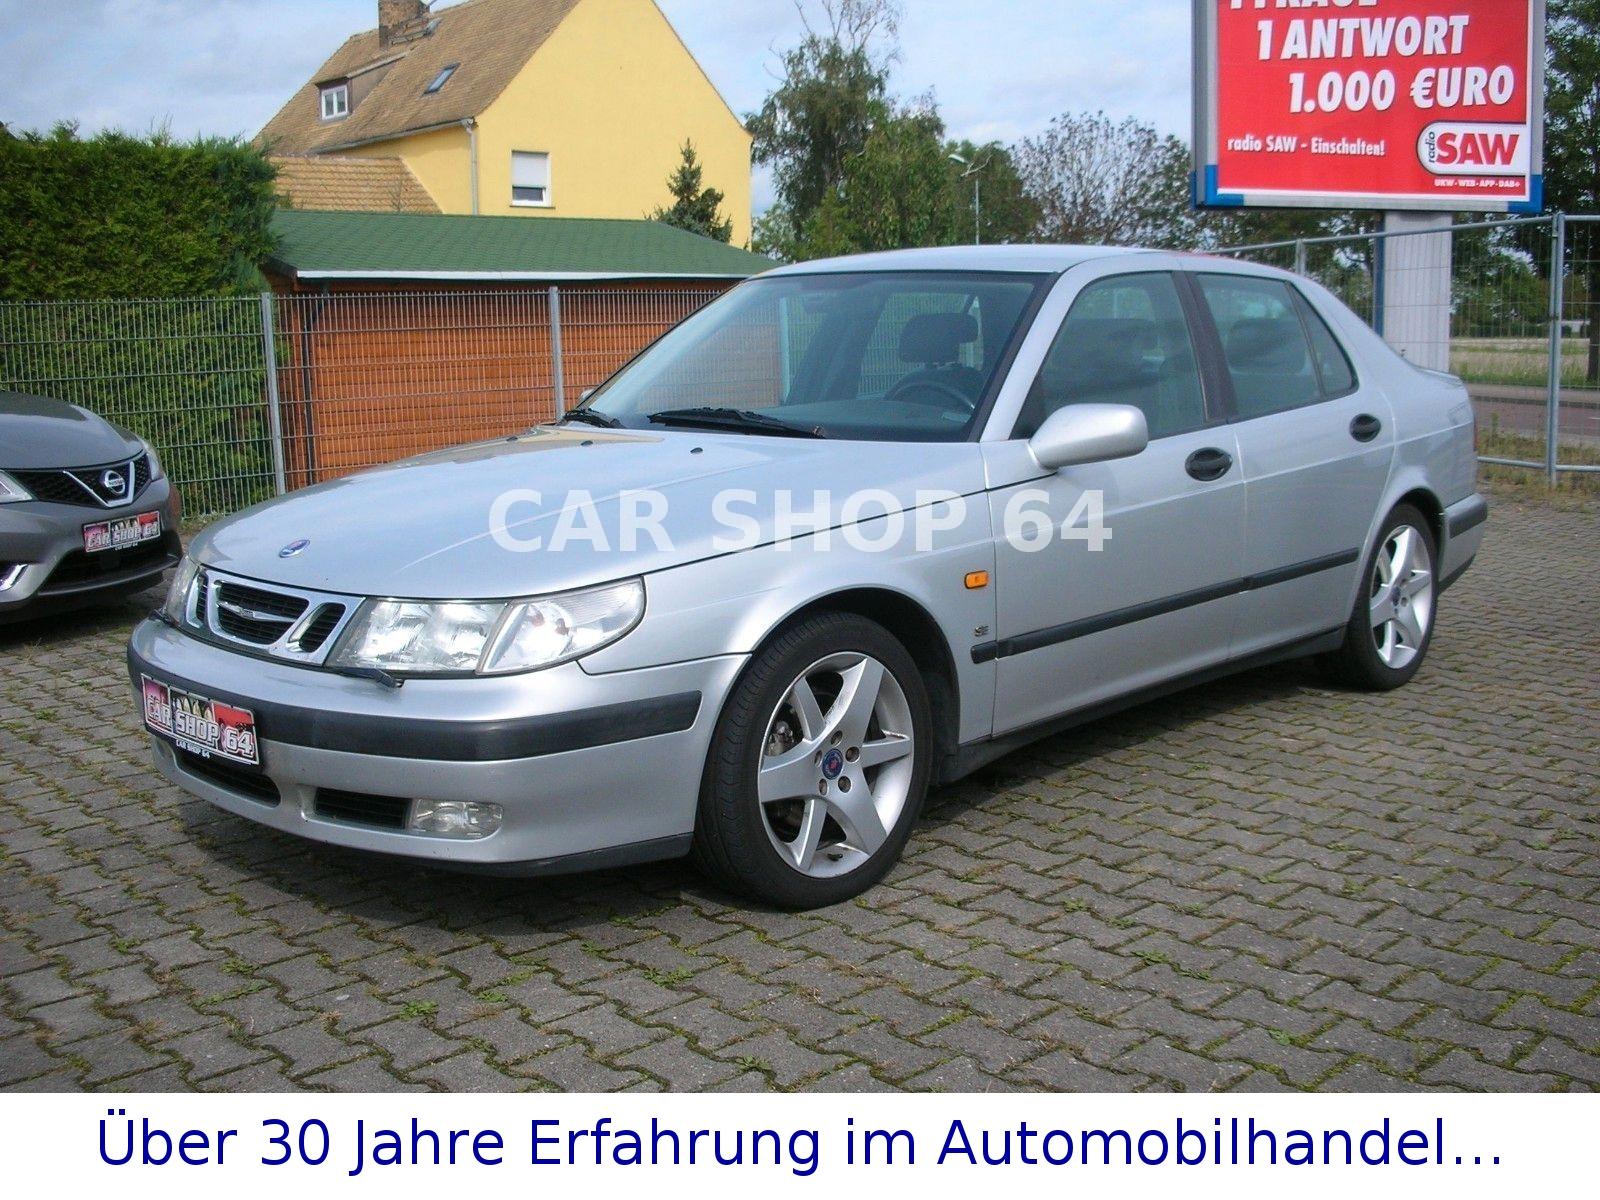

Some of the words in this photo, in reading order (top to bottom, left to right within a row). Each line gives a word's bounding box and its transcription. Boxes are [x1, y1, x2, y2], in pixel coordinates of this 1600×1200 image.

[1257, 20, 1273, 60] 1
[1280, 15, 1469, 60] ANTWORT
[1289, 70, 1396, 113] 1.000
[1410, 65, 1515, 108] €URO
[1227, 134, 1262, 151] radio
[1266, 135, 1298, 152] SAW
[1311, 137, 1385, 156] Einschalten!
[1425, 131, 1436, 163] radio
[1436, 132, 1519, 165] SAW
[147, 694, 172, 726] CAR
[175, 708, 220, 745] SHOP
[223, 726, 255, 758] 64
